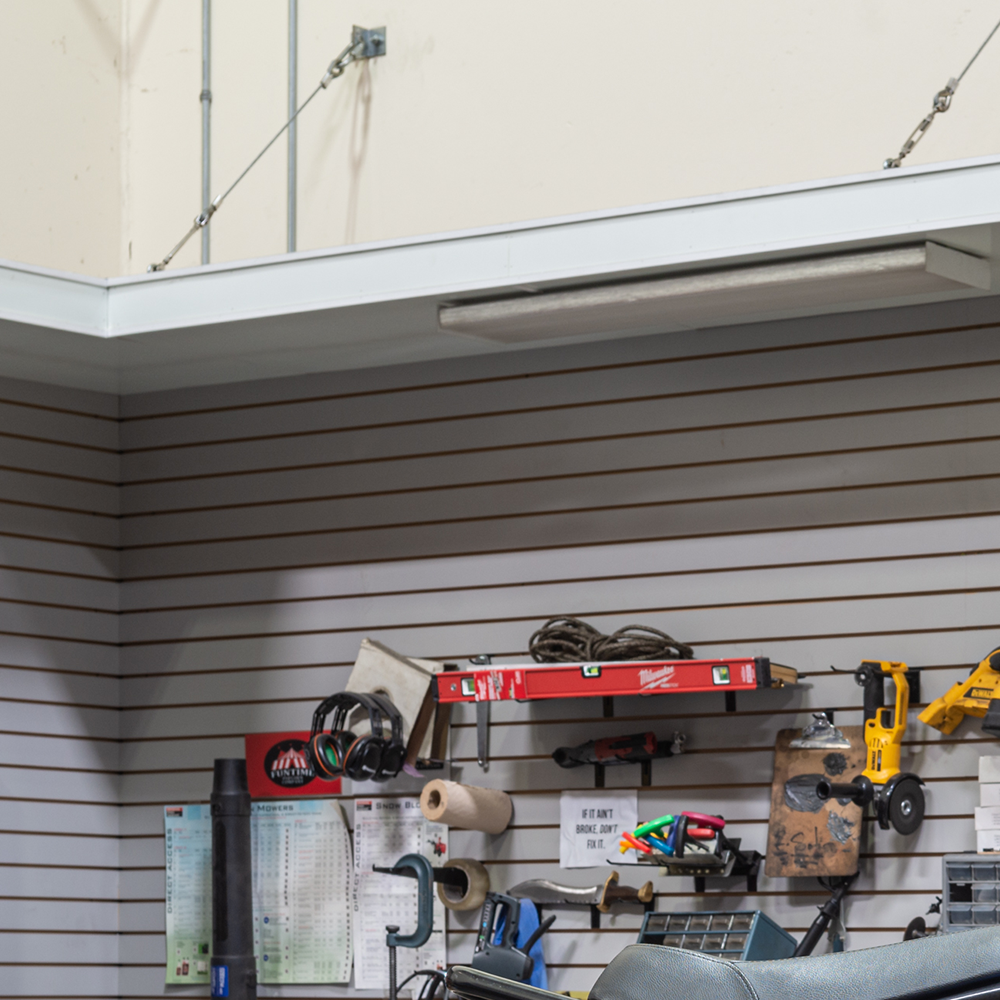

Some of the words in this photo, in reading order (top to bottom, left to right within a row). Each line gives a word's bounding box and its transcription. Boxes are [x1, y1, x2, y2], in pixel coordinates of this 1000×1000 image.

[376, 802, 400, 810] SNOW
[582, 808, 588, 819] IF
[589, 808, 595, 819] IT
[597, 808, 613, 819] AIN'T
[600, 824, 618, 834] DON'T
[587, 840, 596, 849] FIX
